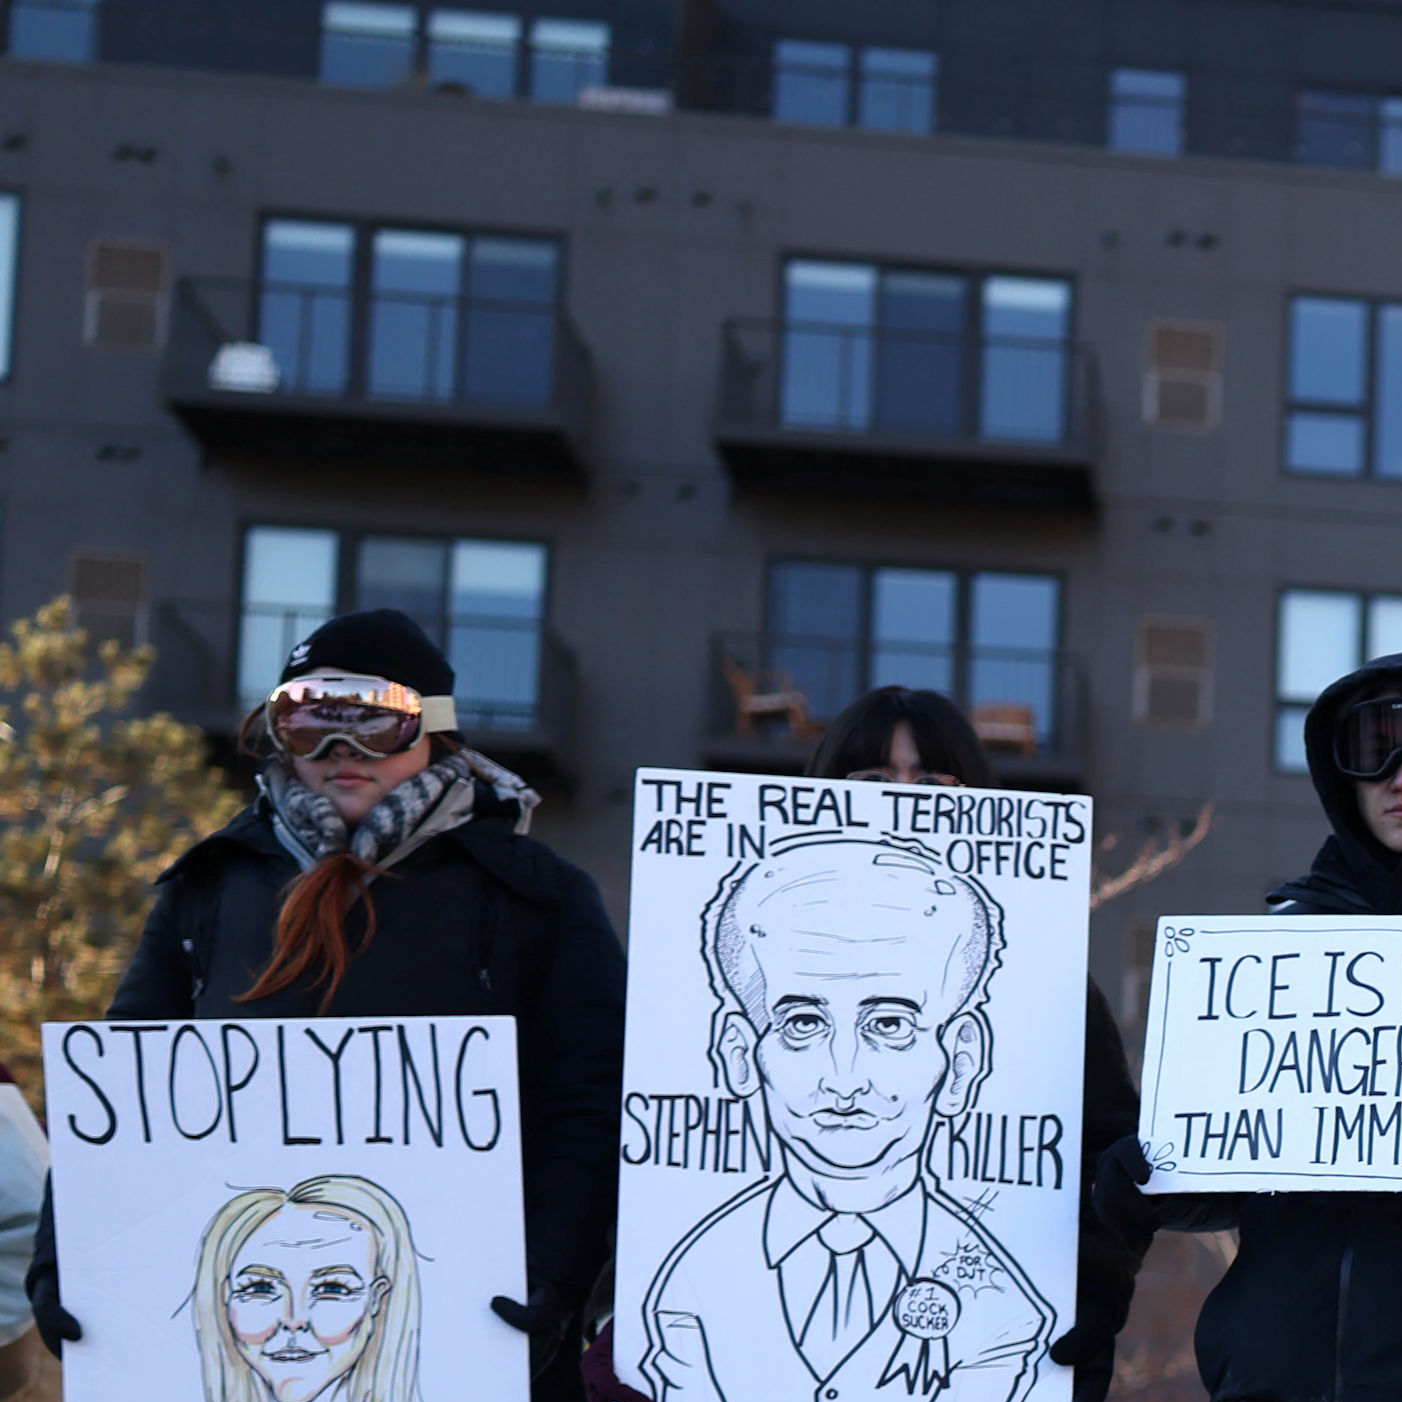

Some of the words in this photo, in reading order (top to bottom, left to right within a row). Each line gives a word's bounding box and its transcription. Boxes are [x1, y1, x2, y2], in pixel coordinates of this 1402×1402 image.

[641, 779, 732, 818] THE
[758, 784, 869, 828] REAL
[882, 790, 1087, 844] TERRORISTS
[640, 819, 706, 857] ARE
[726, 823, 766, 859] IN
[946, 839, 1071, 881] OFFICE
[1197, 953, 1300, 1021] ICE
[1312, 951, 1385, 1017] IS
[62, 1024, 260, 1145] STOP
[277, 1023, 502, 1152] LYING
[621, 1092, 770, 1172] STEPHEN
[949, 1112, 1064, 1190] KILLER
[1175, 1107, 1284, 1161] THAN
[960, 1256, 982, 1266] FOR
[903, 1314, 948, 1330] SUCKER
[908, 1302, 948, 1314] COCK
